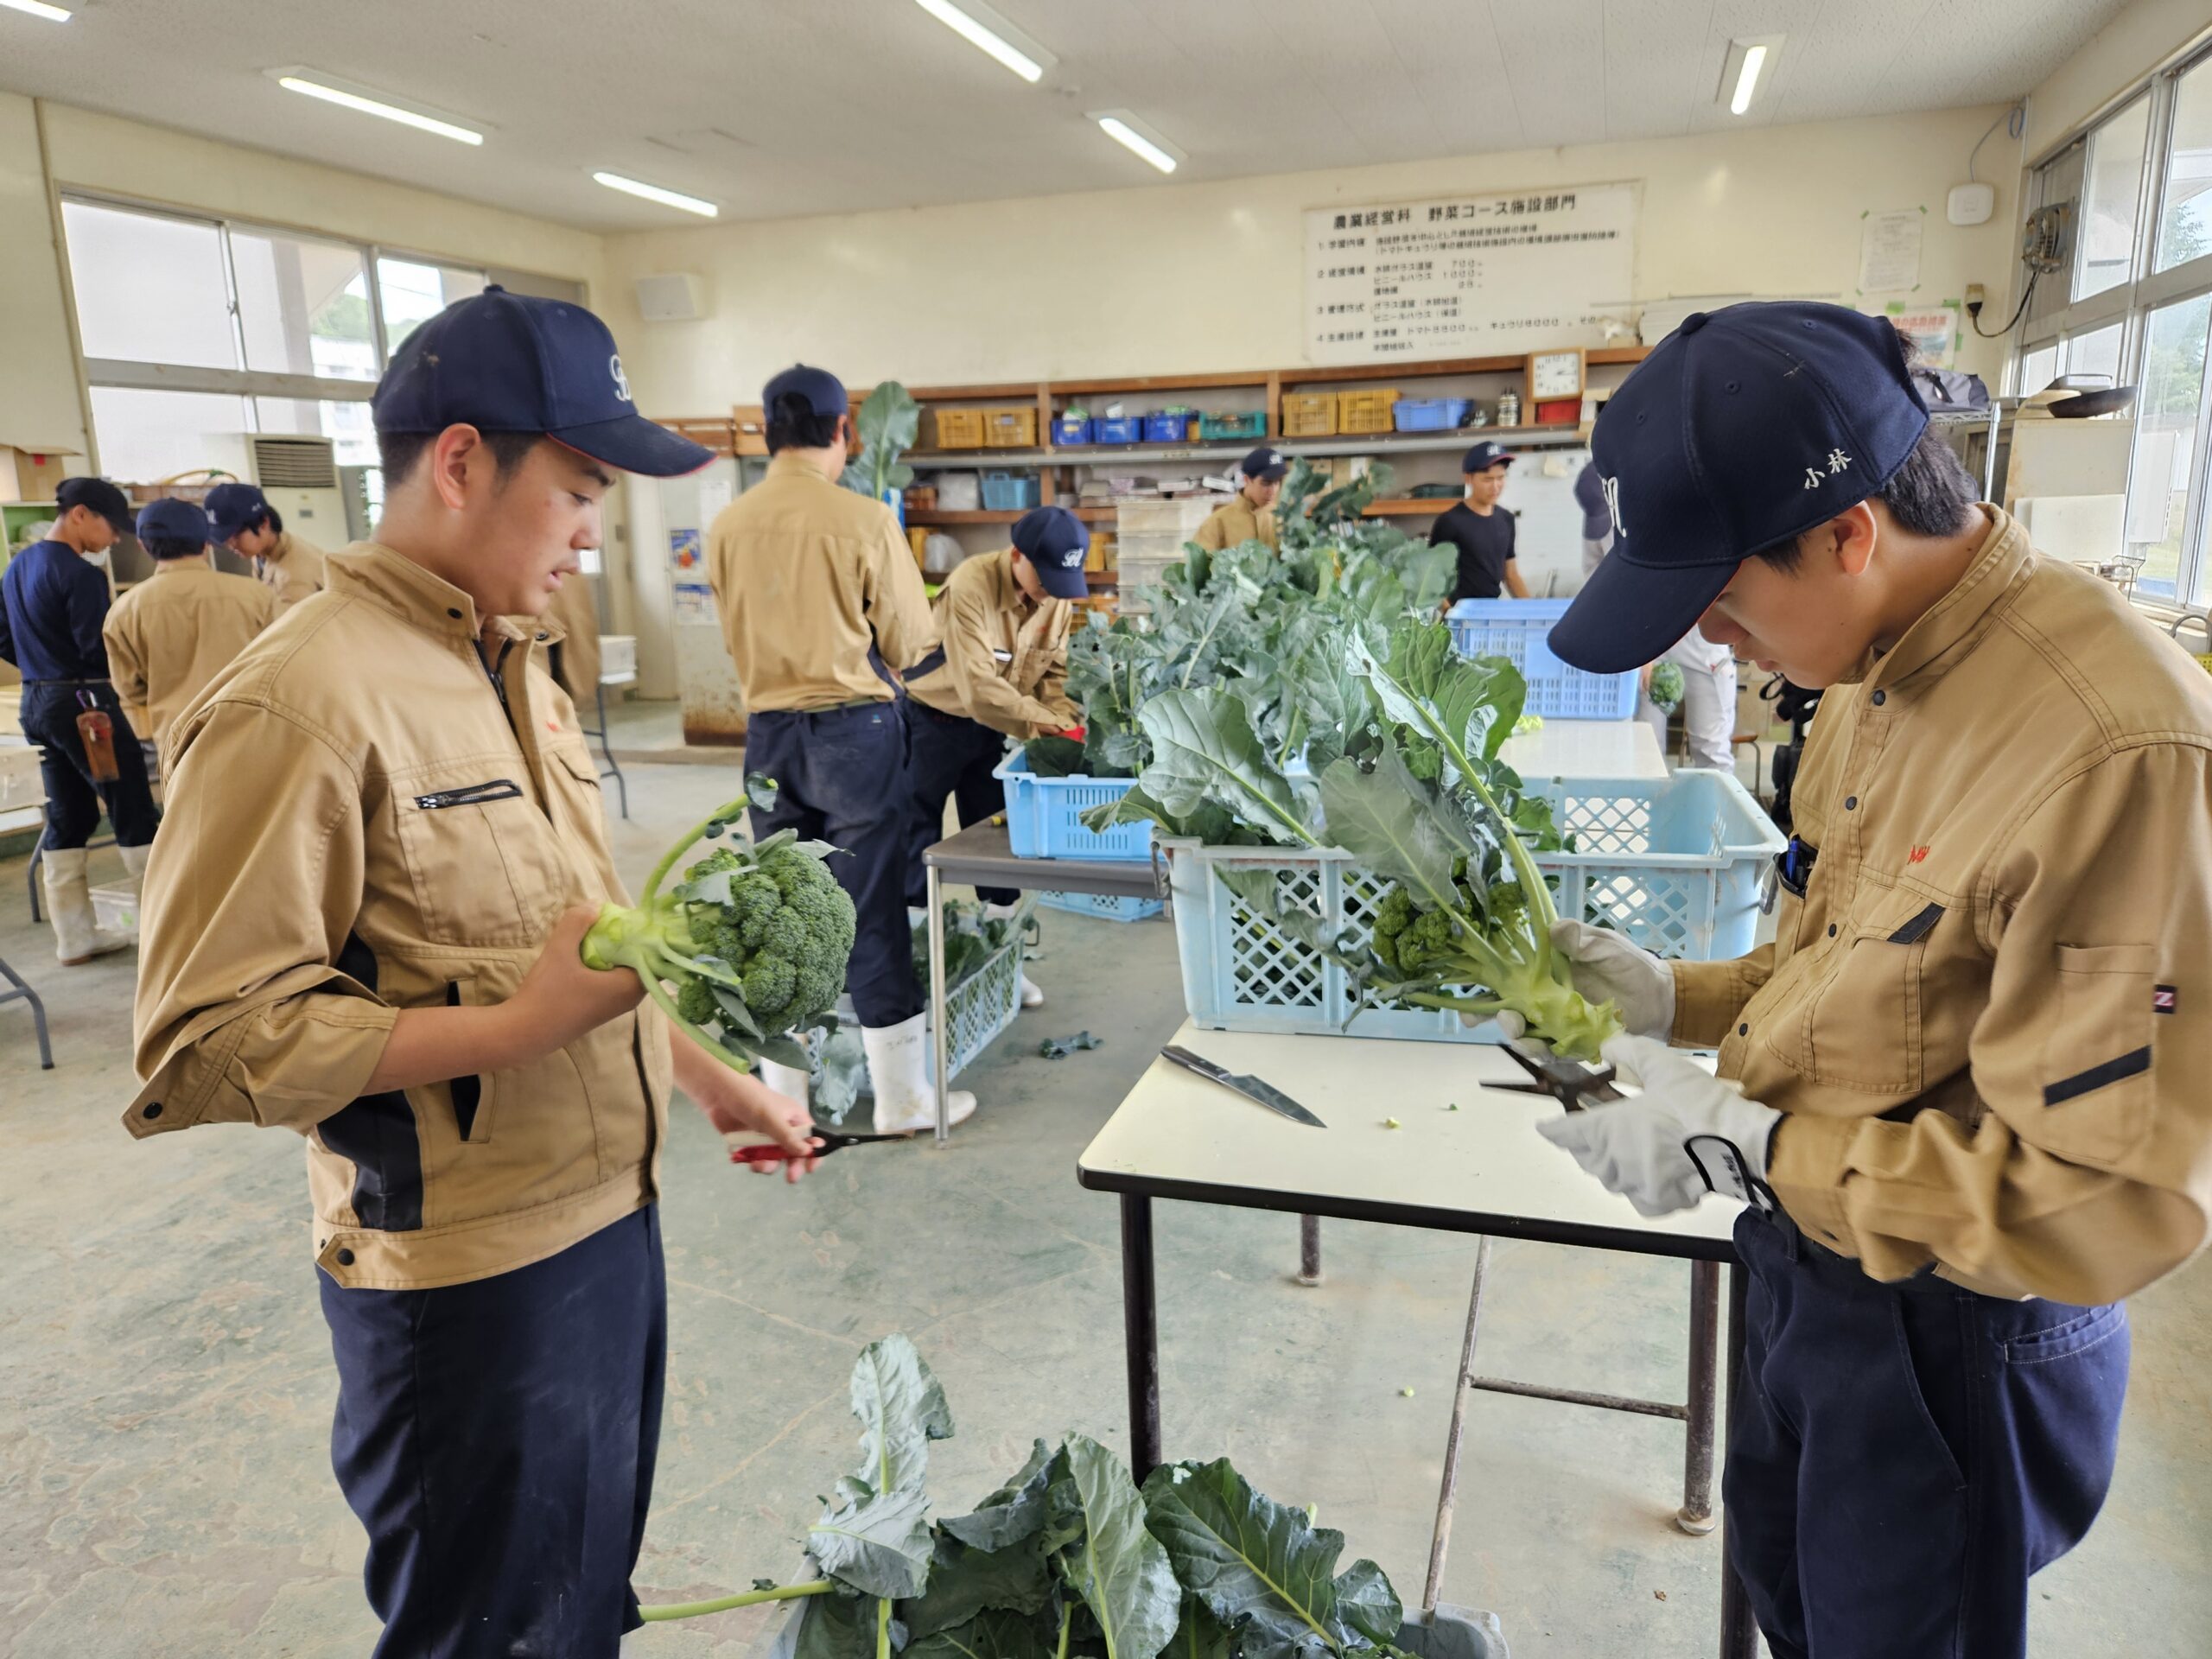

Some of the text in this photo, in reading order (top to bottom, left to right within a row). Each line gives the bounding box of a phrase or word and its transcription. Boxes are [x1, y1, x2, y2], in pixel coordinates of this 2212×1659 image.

[1333, 194, 1576, 230] 農業経営科 野菜コース施設部門
[1803, 448, 1853, 490] 小林
